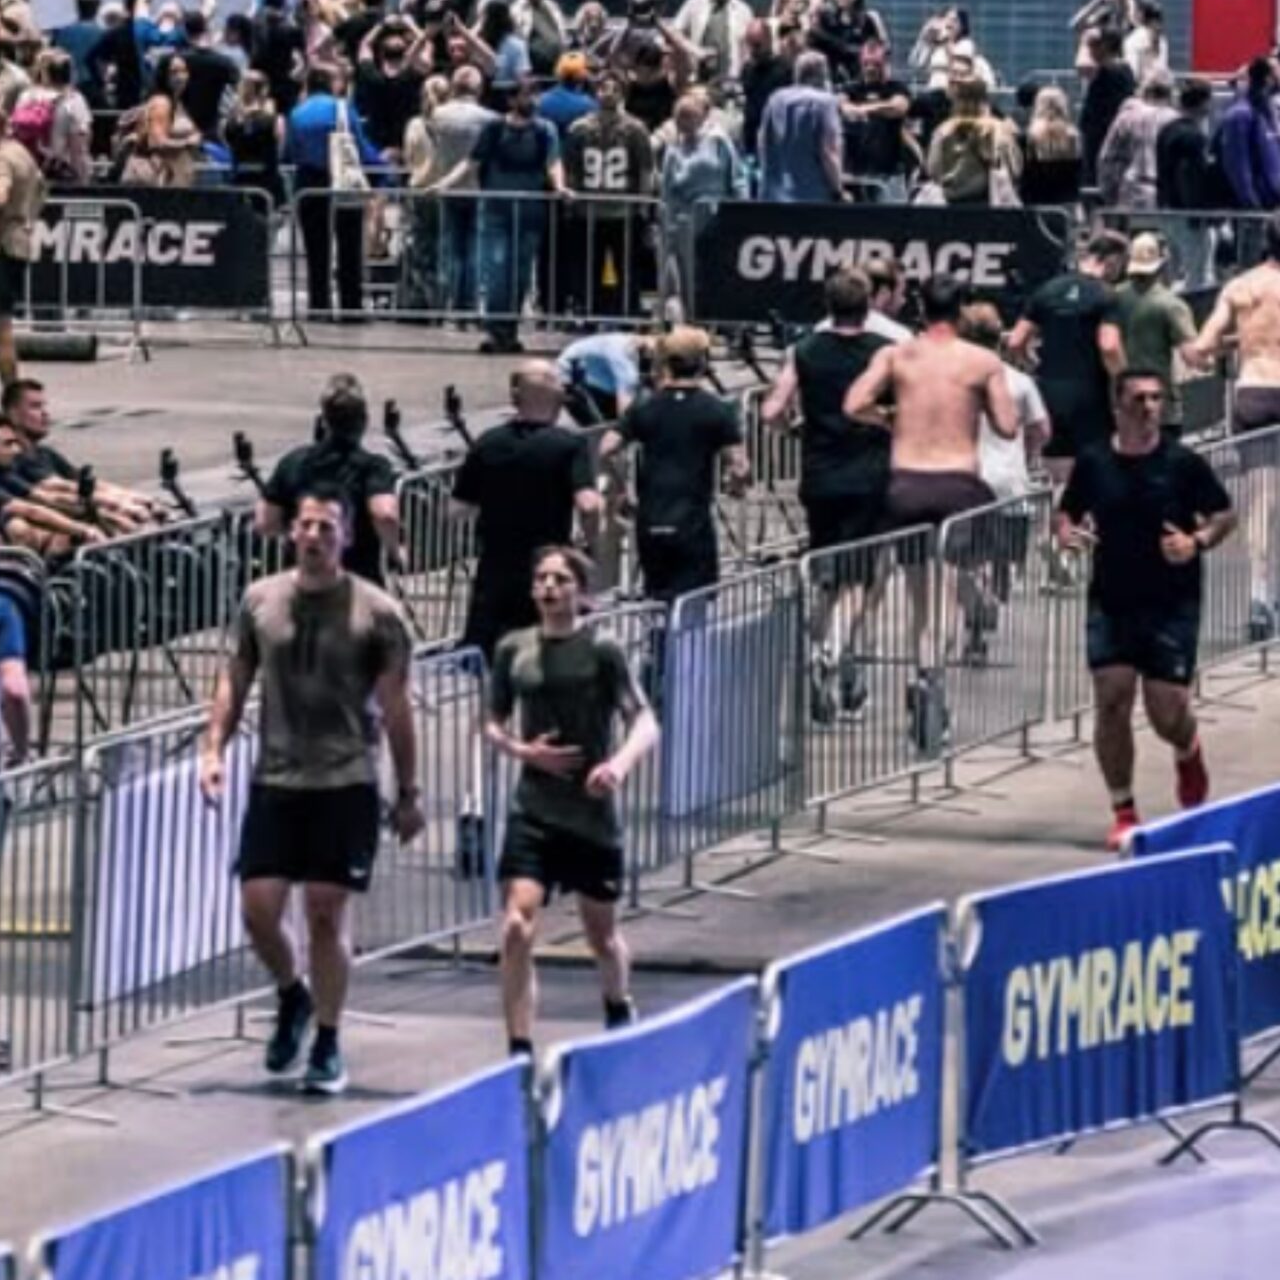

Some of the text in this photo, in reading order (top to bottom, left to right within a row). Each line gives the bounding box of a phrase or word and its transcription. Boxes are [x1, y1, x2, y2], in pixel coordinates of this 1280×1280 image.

[584, 146, 628, 189] 92
[794, 992, 923, 1144] GYMRACE
[1002, 930, 1201, 1067] GYMRACE
[573, 1073, 729, 1239] GYMRACE
